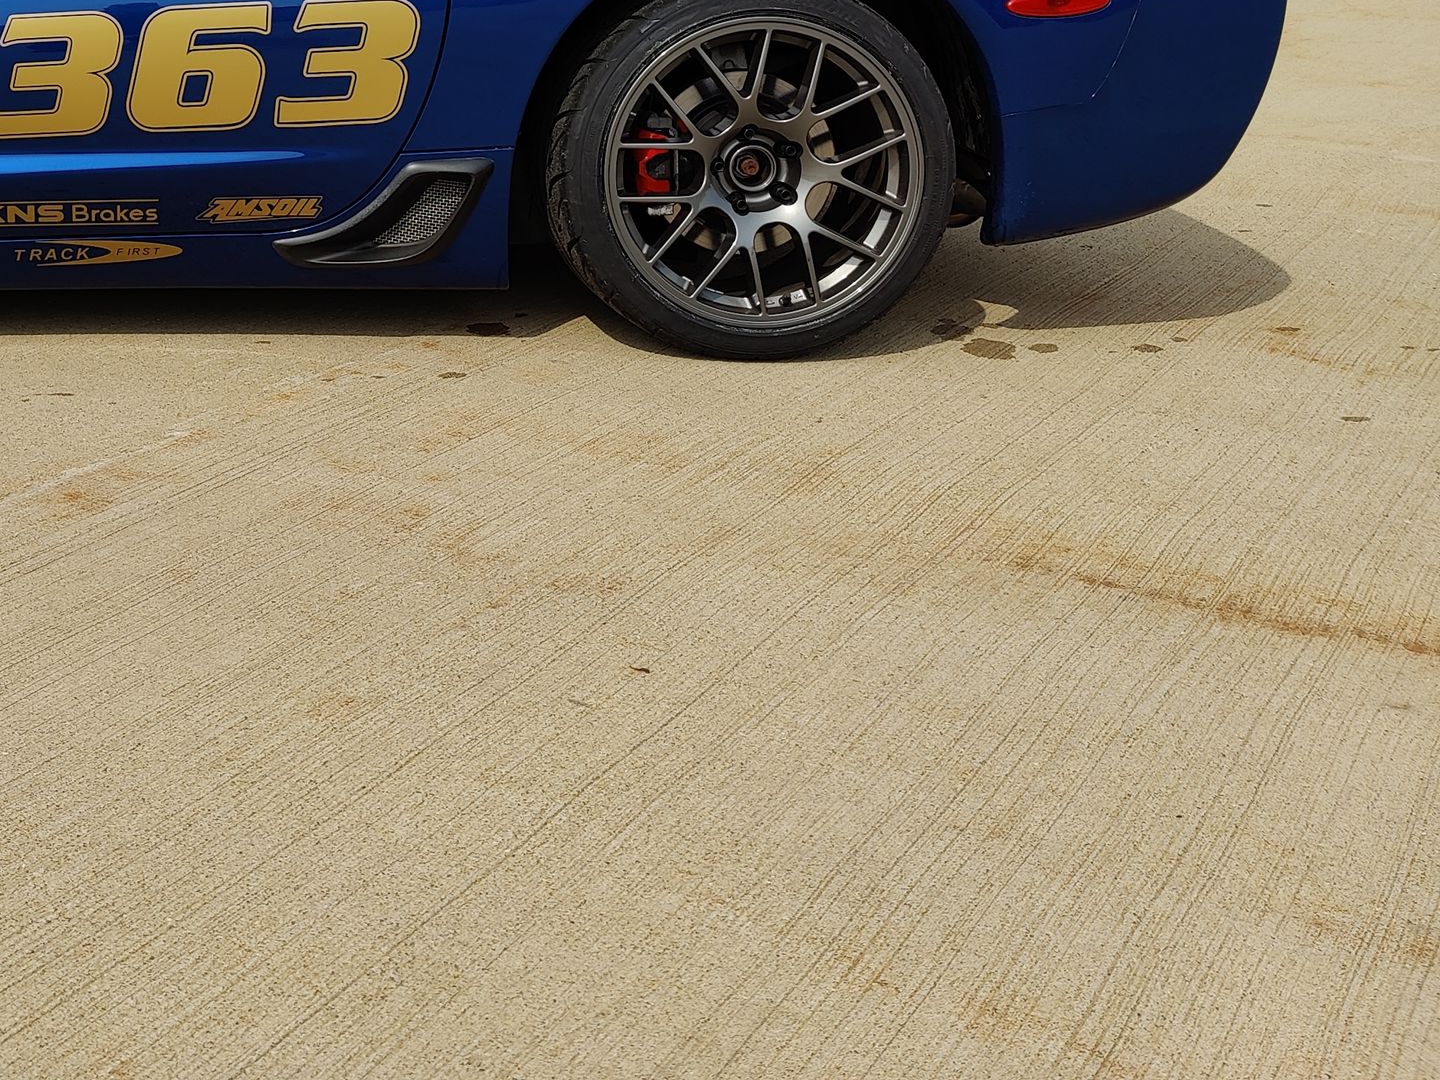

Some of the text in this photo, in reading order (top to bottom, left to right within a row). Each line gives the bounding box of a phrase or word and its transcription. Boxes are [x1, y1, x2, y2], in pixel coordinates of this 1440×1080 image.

[71, 204, 158, 222] Brakes
[202, 198, 319, 221] AMSOIL
[14, 247, 161, 262] TRACK FIRST
